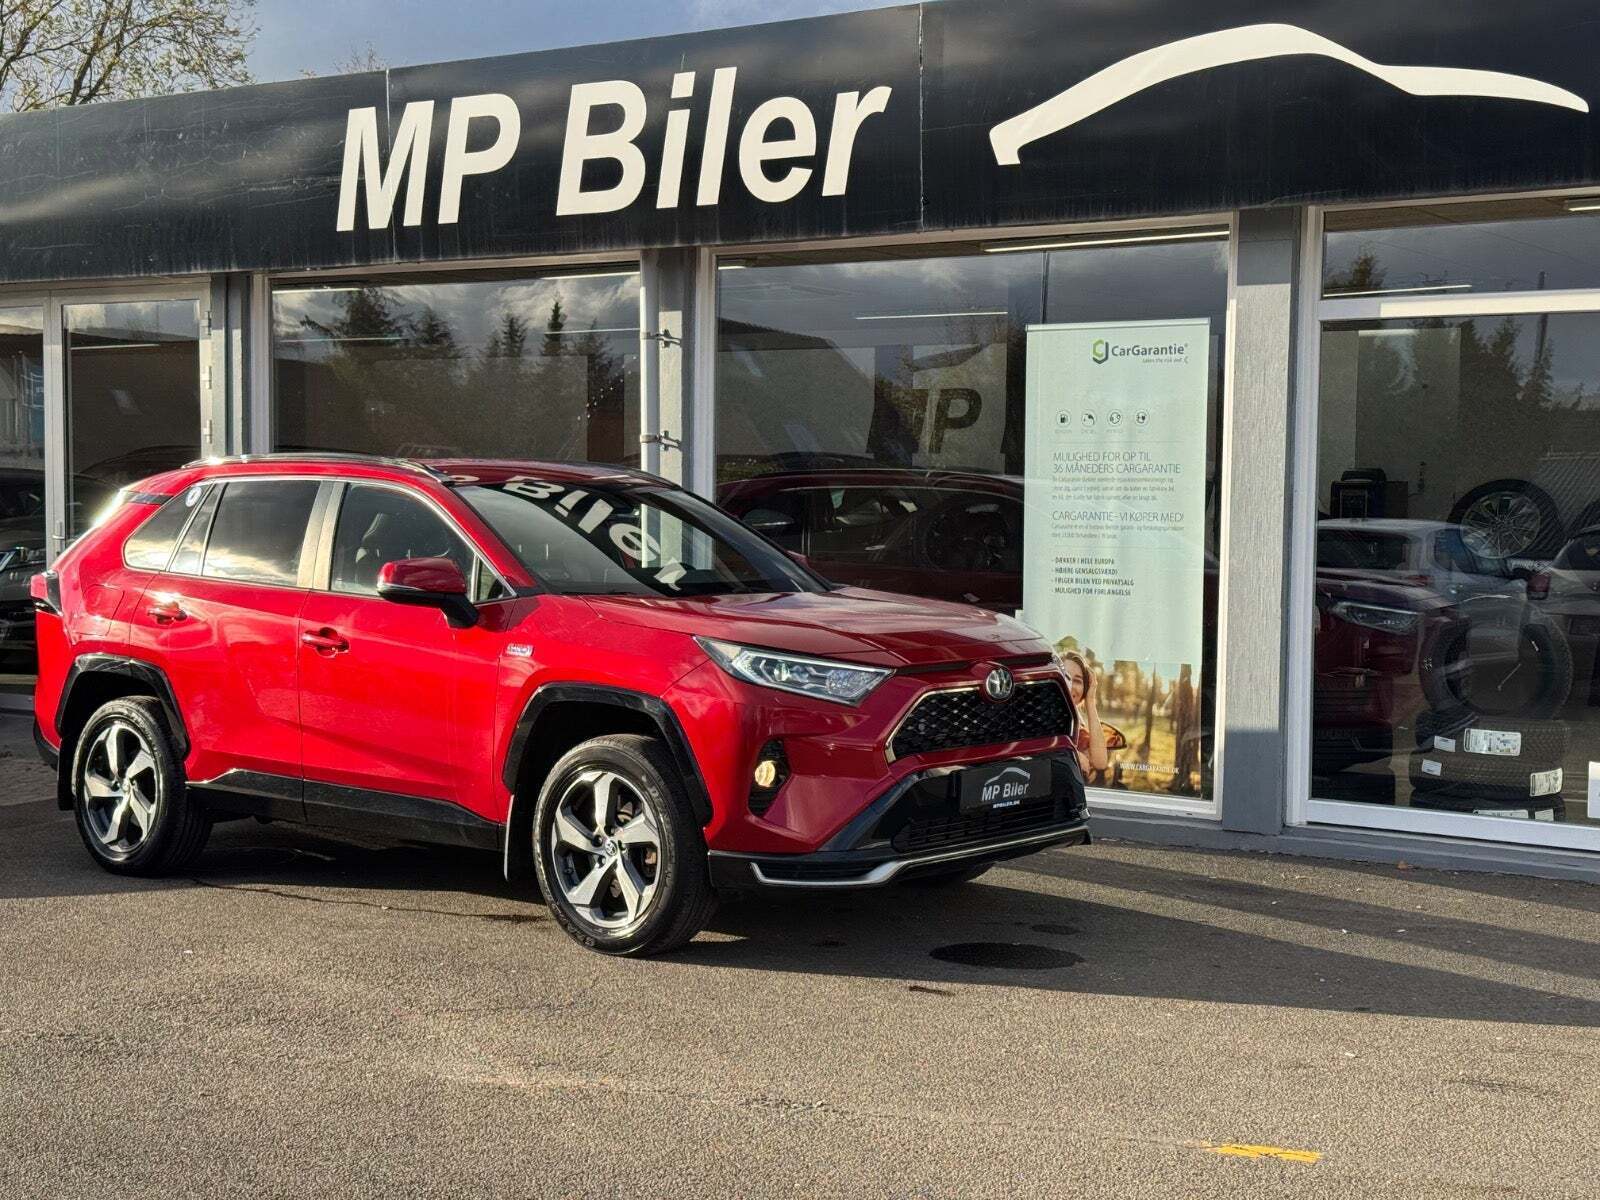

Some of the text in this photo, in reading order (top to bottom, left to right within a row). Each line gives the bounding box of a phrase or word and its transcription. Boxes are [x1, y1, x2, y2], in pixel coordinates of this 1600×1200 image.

[336, 66, 892, 232] MP Biler
[1111, 344, 1185, 357] CarGarantie
[1053, 452, 1152, 462] MULIGHED FOR OP TIL
[1053, 462, 1181, 474] 36 MÅNEDERS CARGARANTIE
[1052, 510, 1113, 521] CARGARANTIE
[1094, 557, 1115, 565] EUROPA
[1075, 577, 1090, 585] BILEN
[1091, 577, 1102, 585] VED
[1102, 578, 1135, 586] PRIVATSALG
[1055, 587, 1081, 595] MULIGHED
[1082, 587, 1093, 595] FOR
[981, 782, 1030, 802] MP Biler
